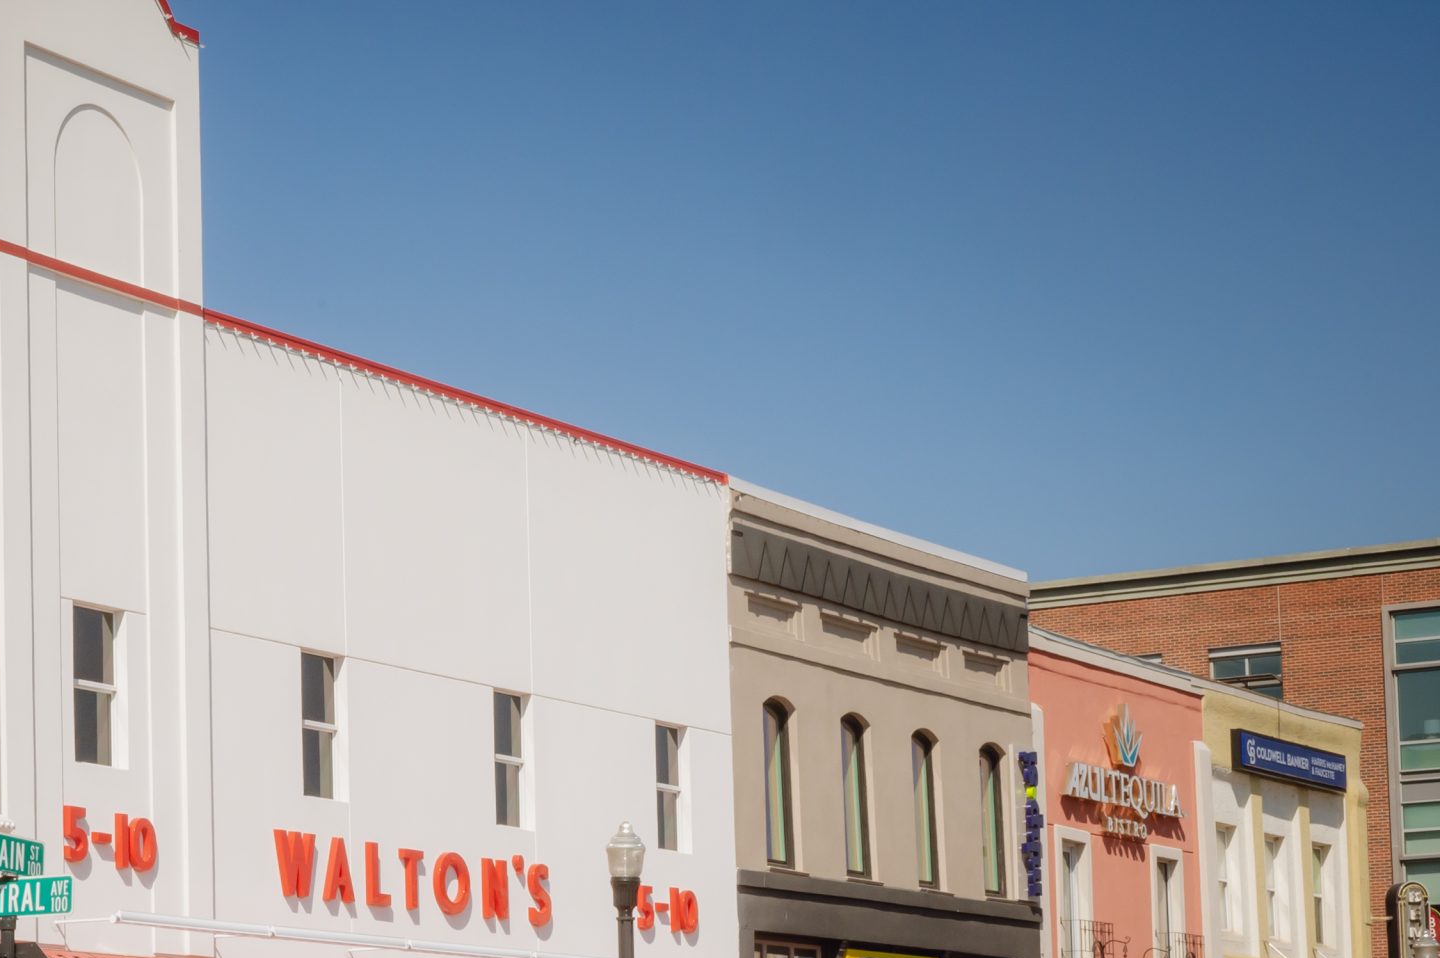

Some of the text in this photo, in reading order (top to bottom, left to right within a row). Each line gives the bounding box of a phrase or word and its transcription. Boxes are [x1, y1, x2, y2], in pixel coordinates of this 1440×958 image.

[1256, 746, 1287, 765] COLDWELL
[1287, 753, 1310, 770] BANKER
[62, 805, 157, 872] 5-10
[29, 845, 40, 860] ST
[27, 860, 41, 876] 100
[273, 828, 553, 927] WALTON'S
[50, 880, 69, 896] AVE
[51, 896, 68, 913] 100
[637, 885, 699, 934] 5-10
